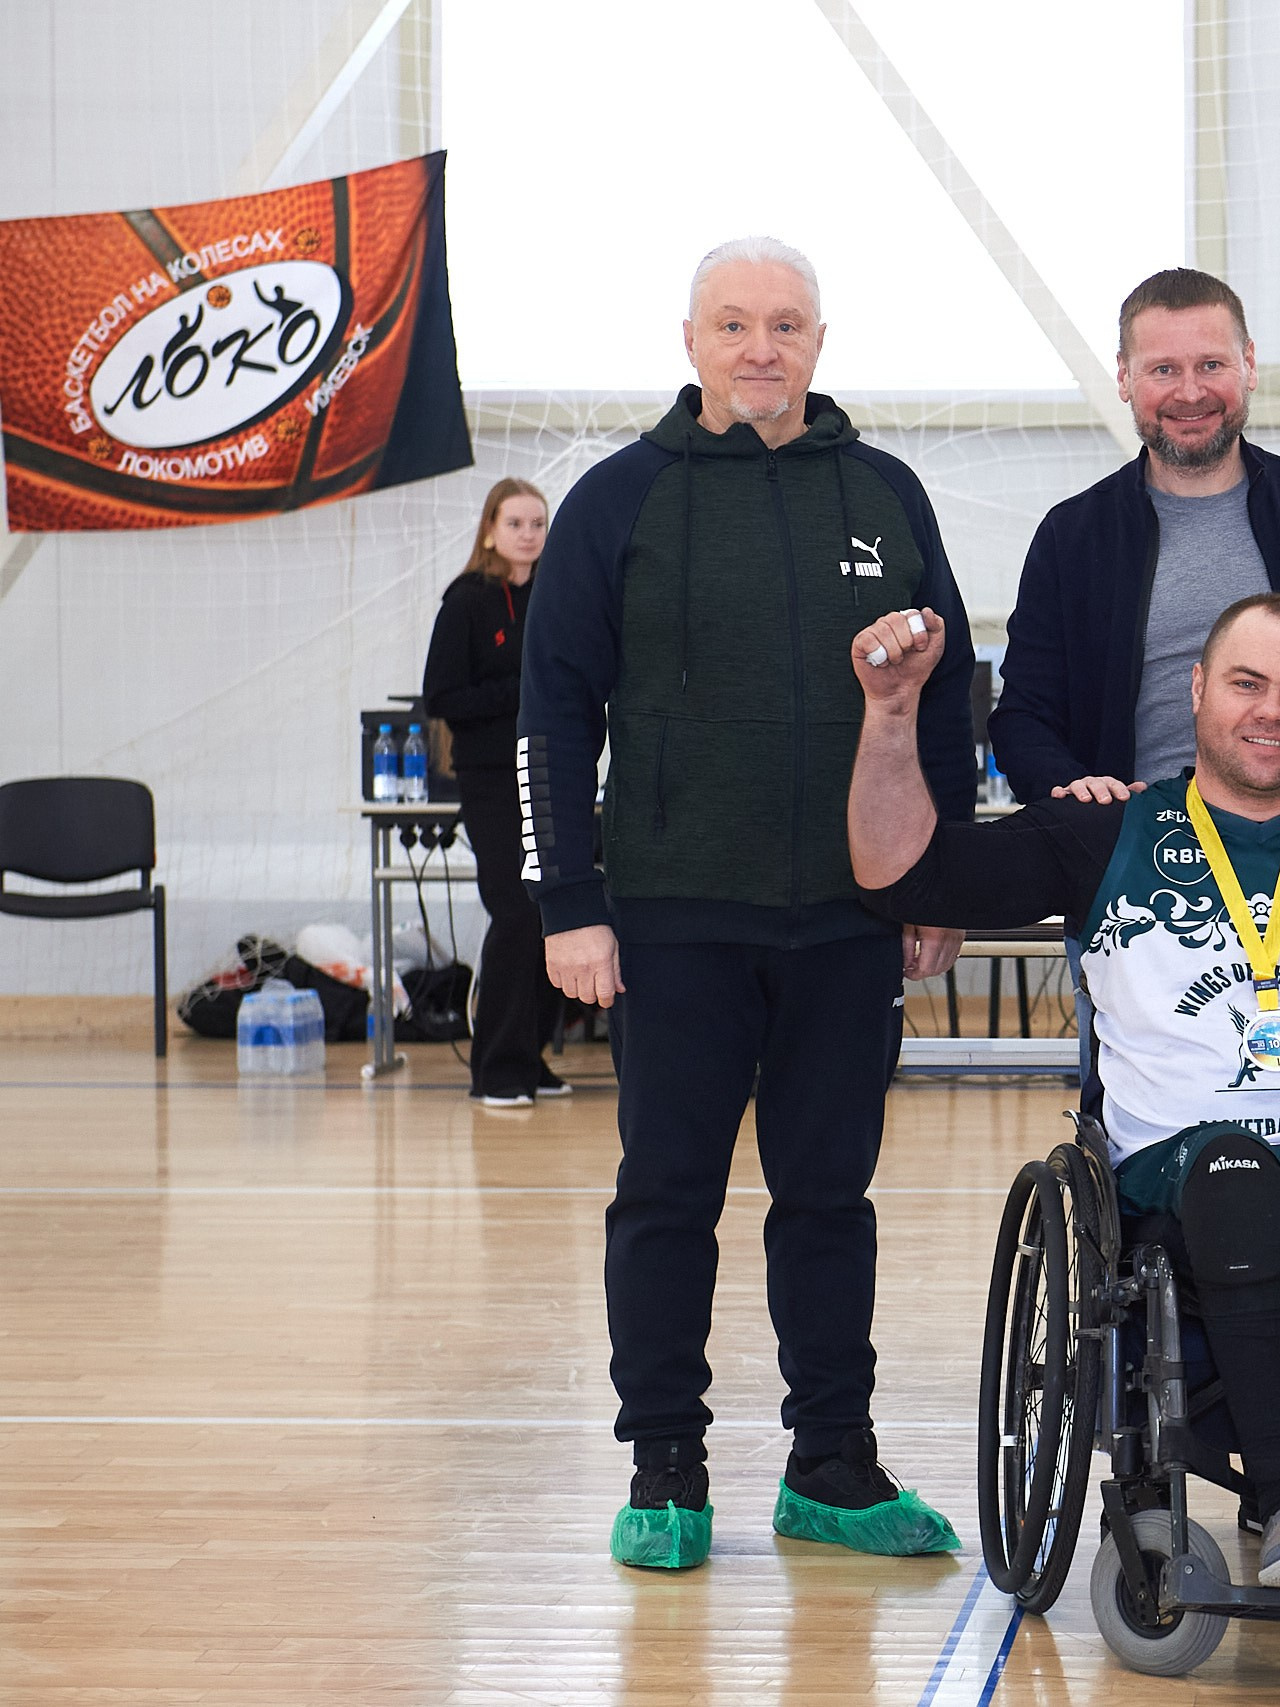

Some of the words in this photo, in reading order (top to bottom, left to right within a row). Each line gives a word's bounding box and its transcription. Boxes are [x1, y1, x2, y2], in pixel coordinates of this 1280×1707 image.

[63, 285, 137, 434] БАСКЕТБОЛ
[130, 271, 170, 304] НА
[166, 227, 285, 284] КОЛЕСАХ
[117, 433, 271, 481] ЛОКОМОТИВ
[1156, 809, 1192, 824] ZED
[1173, 965, 1232, 1018] WINGS
[1268, 1040, 1280, 1048] 10
